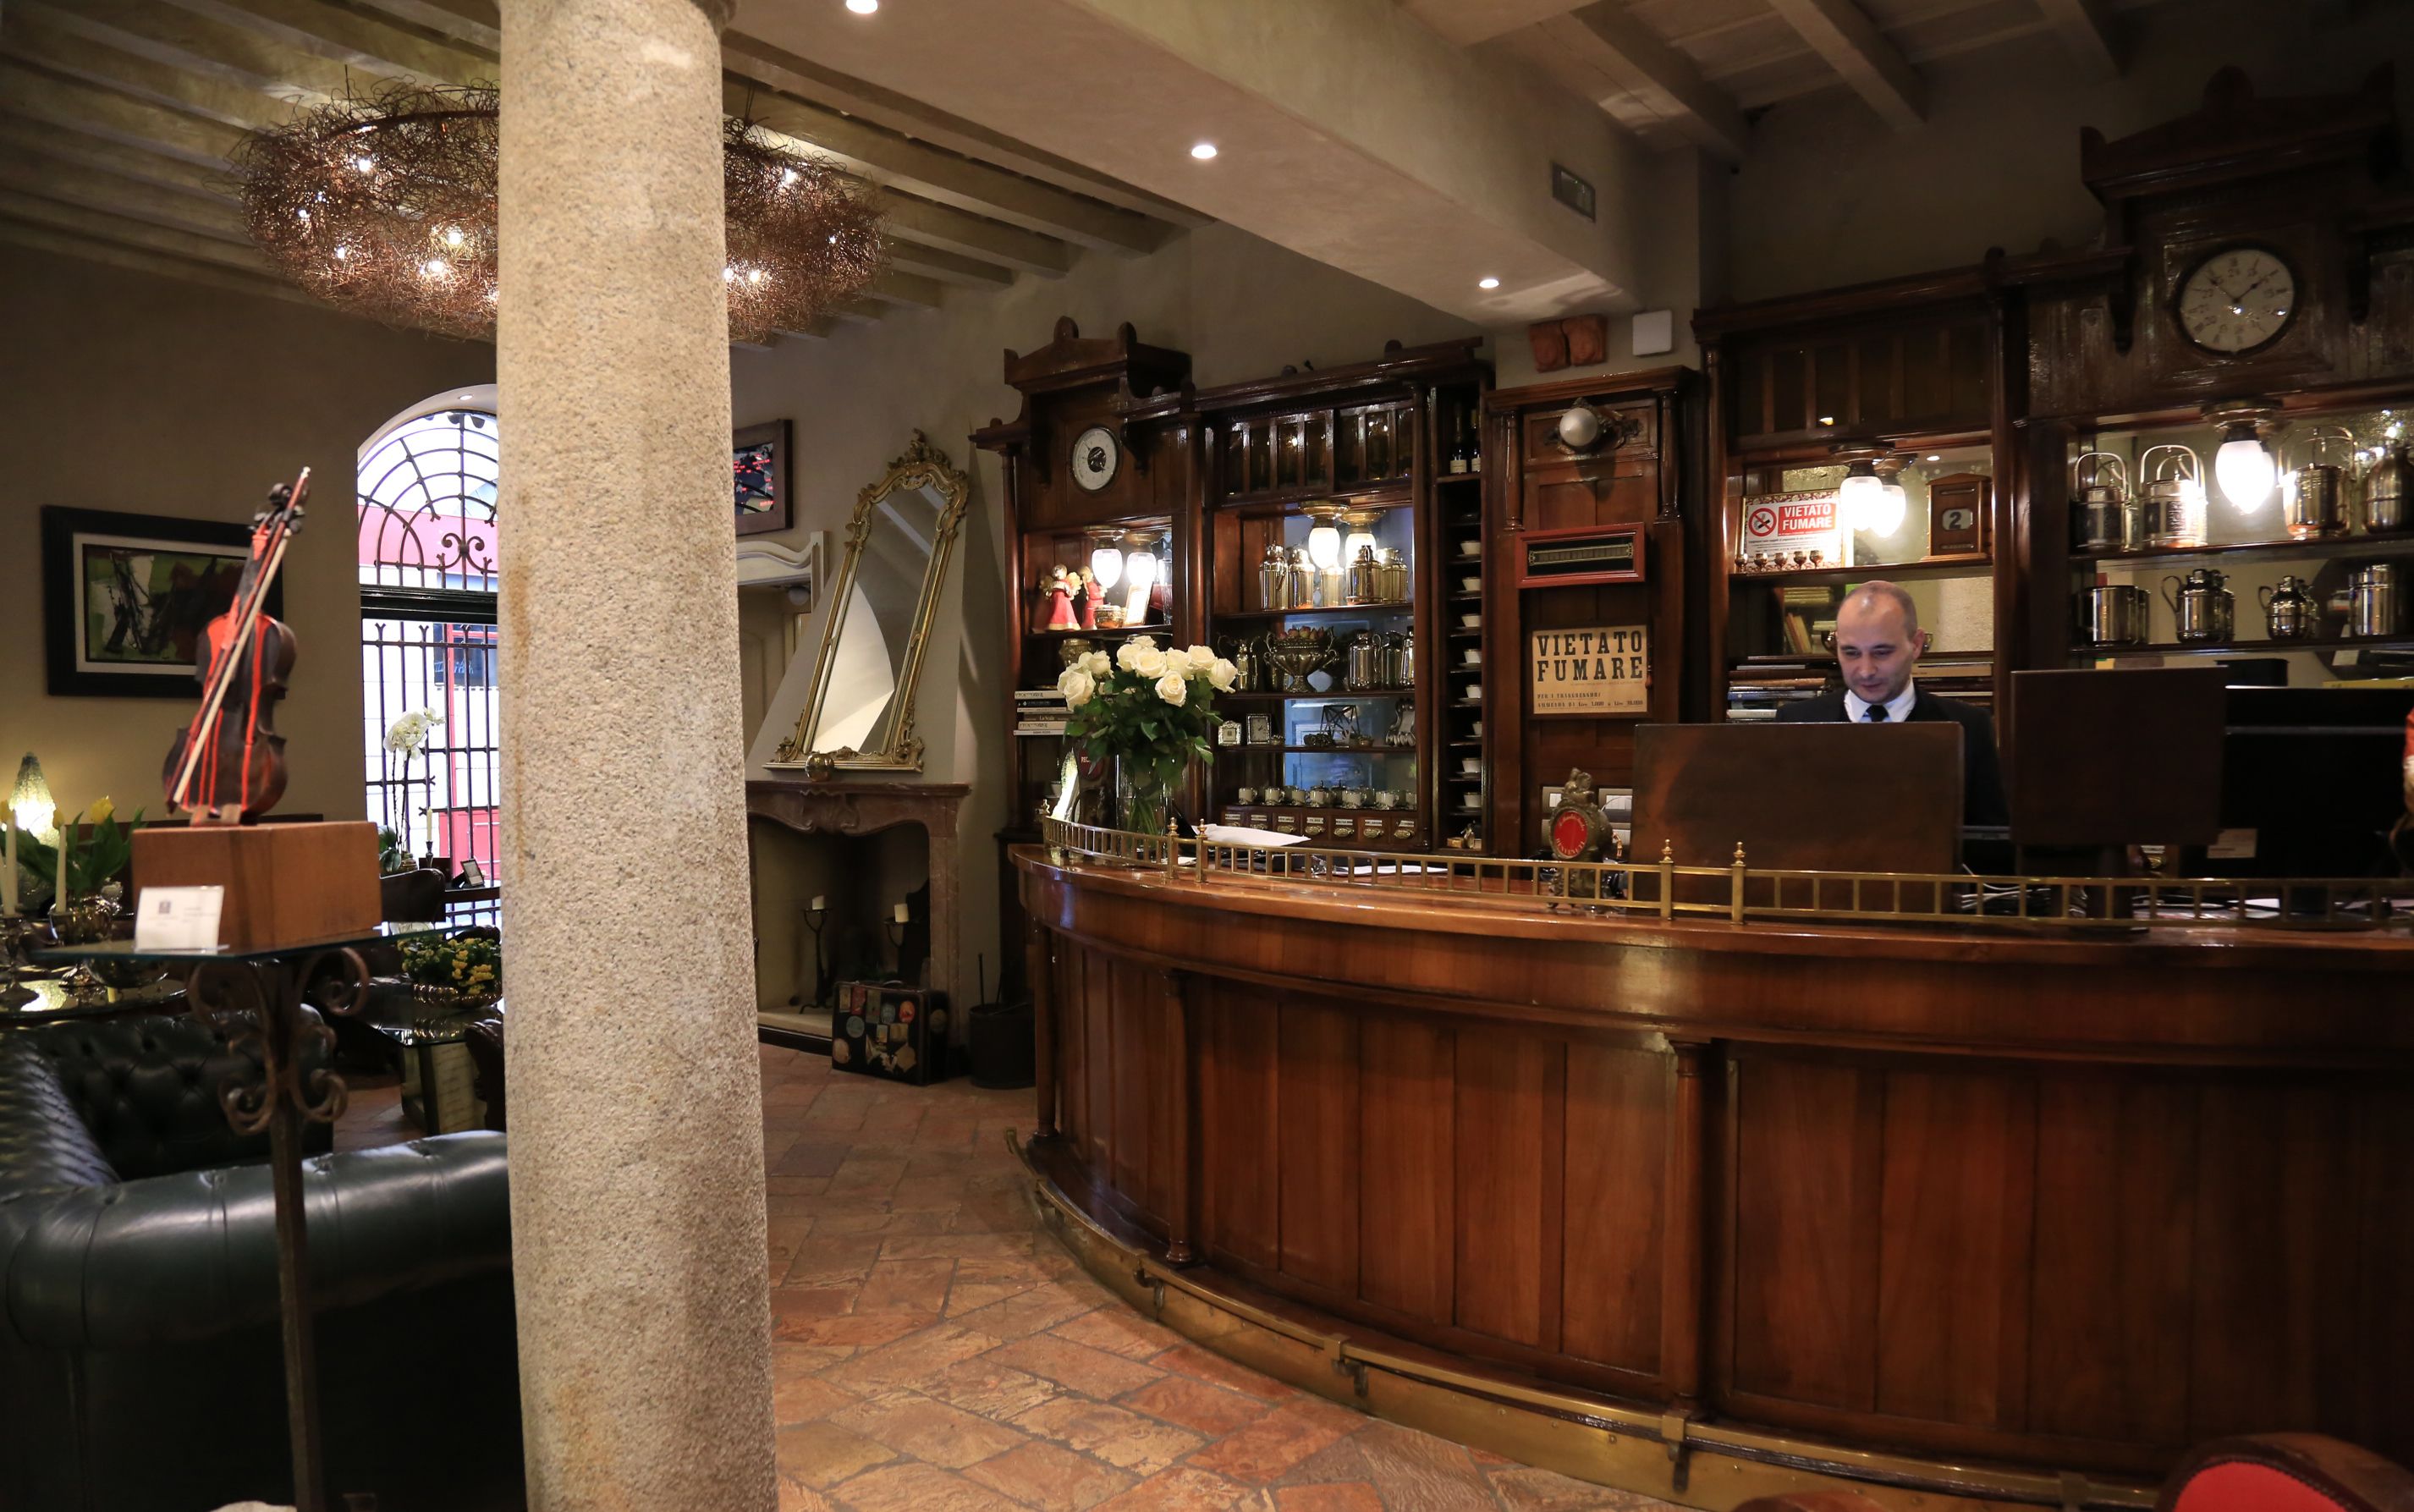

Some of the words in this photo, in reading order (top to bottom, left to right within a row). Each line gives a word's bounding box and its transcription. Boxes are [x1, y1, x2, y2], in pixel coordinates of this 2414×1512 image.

[1784, 504, 1831, 517] VIETATO
[1783, 516, 1832, 530] FUMARE
[1949, 511, 1961, 530] 2
[1537, 630, 1642, 657] VIETATO
[1537, 657, 1643, 682] FUMARE
